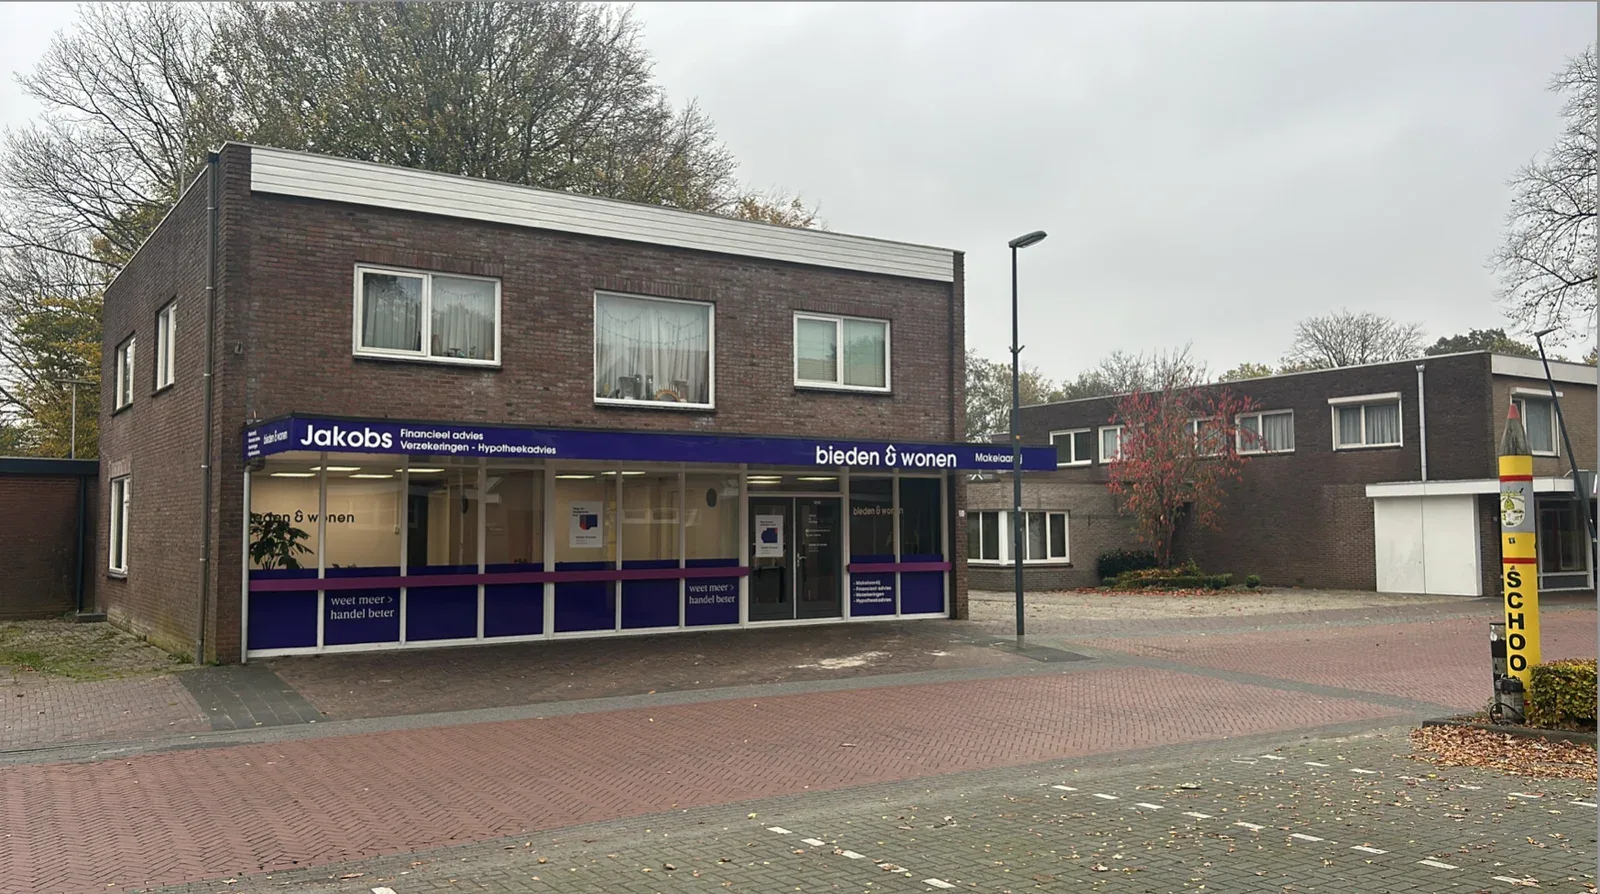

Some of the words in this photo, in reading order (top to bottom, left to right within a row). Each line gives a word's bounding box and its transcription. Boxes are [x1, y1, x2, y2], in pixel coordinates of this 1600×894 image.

[300, 424, 393, 449] Jakobs
[400, 428, 450, 440] Financieel
[452, 430, 484, 441] advies
[400, 441, 469, 453] Verzekeringen
[478, 443, 556, 455] Hypotheekadvies
[816, 445, 880, 466] bieden
[885, 444, 897, 466] &
[901, 452, 957, 467] wonen
[975, 452, 1023, 465] Makelaarj
[294, 509, 304, 523] &
[307, 513, 355, 523] wnen
[853, 506, 875, 516] bieden
[882, 507, 904, 515] wonn
[709, 584, 728, 592] meer
[331, 597, 356, 606] weet
[358, 596, 385, 605] meer
[689, 595, 715, 604] handel
[715, 594, 736, 603] beter
[330, 609, 366, 620] handel
[368, 608, 394, 618] beter
[1507, 571, 1527, 671] SCHOO
